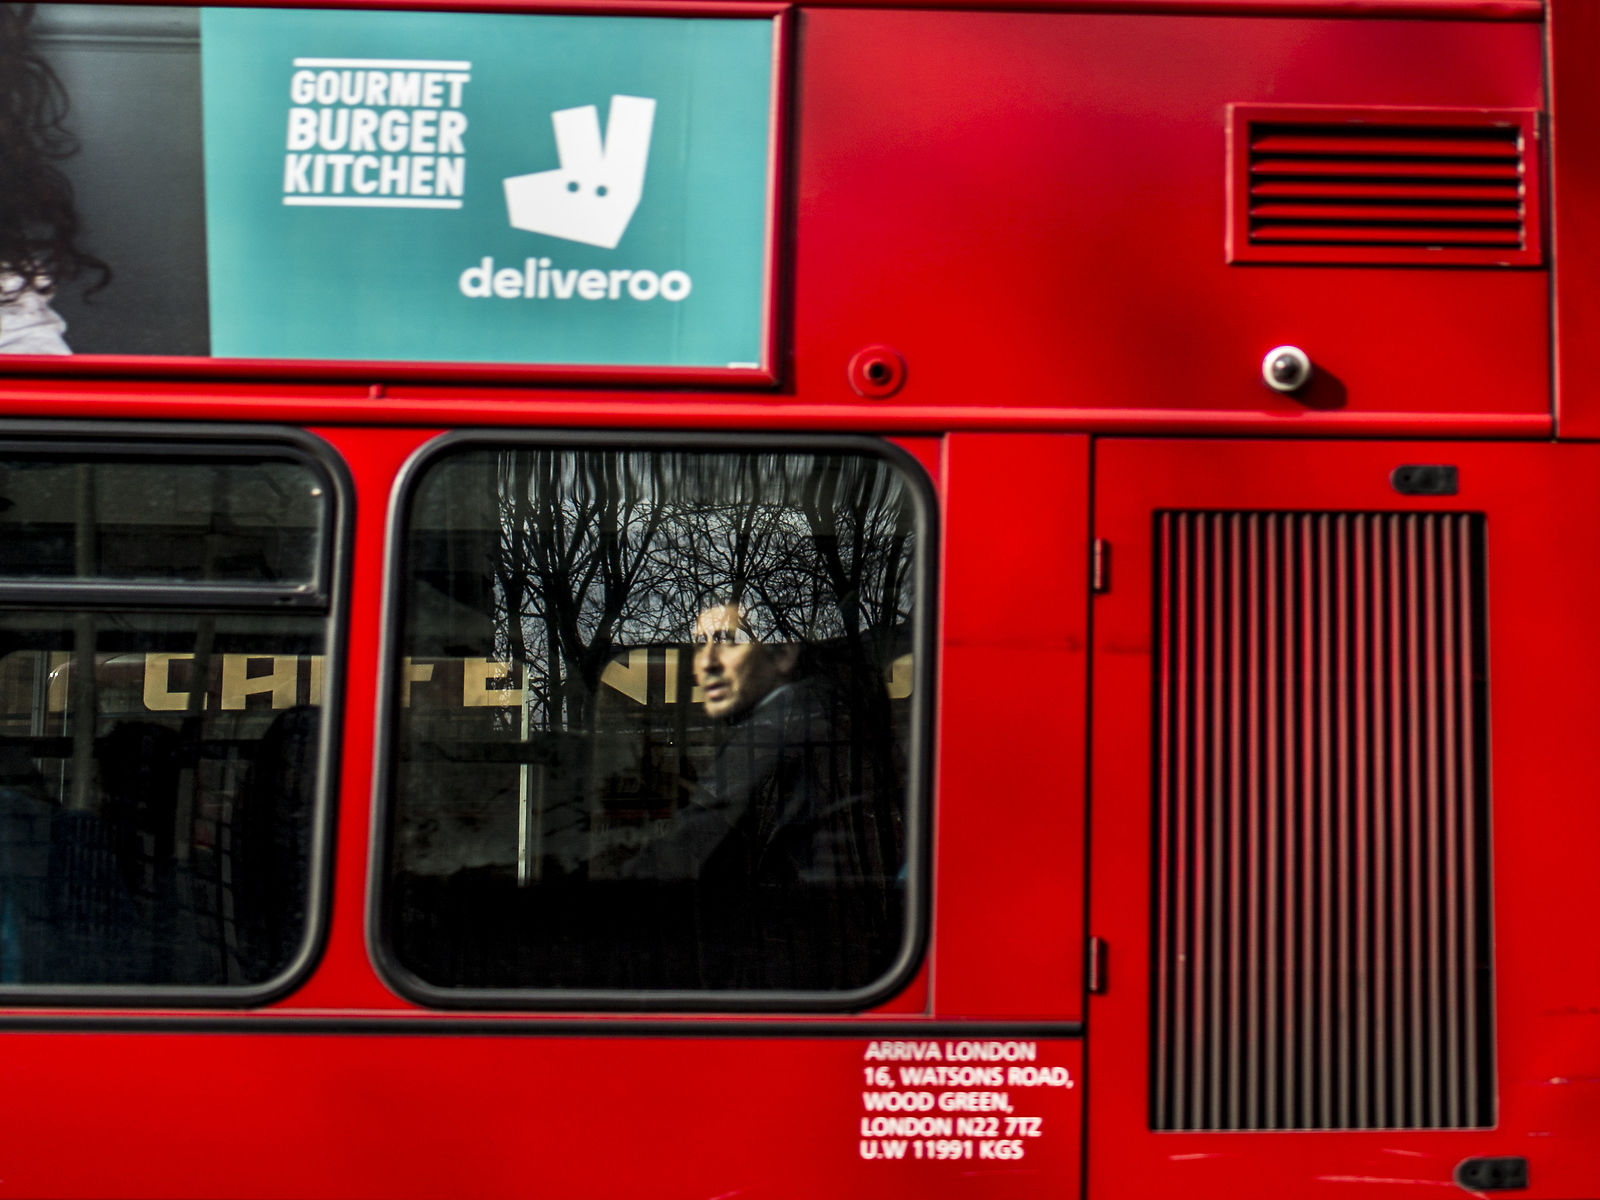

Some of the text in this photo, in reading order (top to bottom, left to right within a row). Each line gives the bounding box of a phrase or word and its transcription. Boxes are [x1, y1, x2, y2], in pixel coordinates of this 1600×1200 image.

[291, 70, 470, 107] GOURMET
[286, 108, 467, 154] BURGER
[284, 154, 465, 196] KITCHEN
[459, 256, 692, 301] deliveroo
[864, 1041, 1036, 1061] ARRIVA LONDON
[864, 1066, 1074, 1089] 16, WATSONS ROAD,
[862, 1091, 1014, 1114] WOOD GREEN,
[860, 1116, 1042, 1137] LONDON N22 7TZ
[860, 1139, 1025, 1160] U.W 11991 KGS
